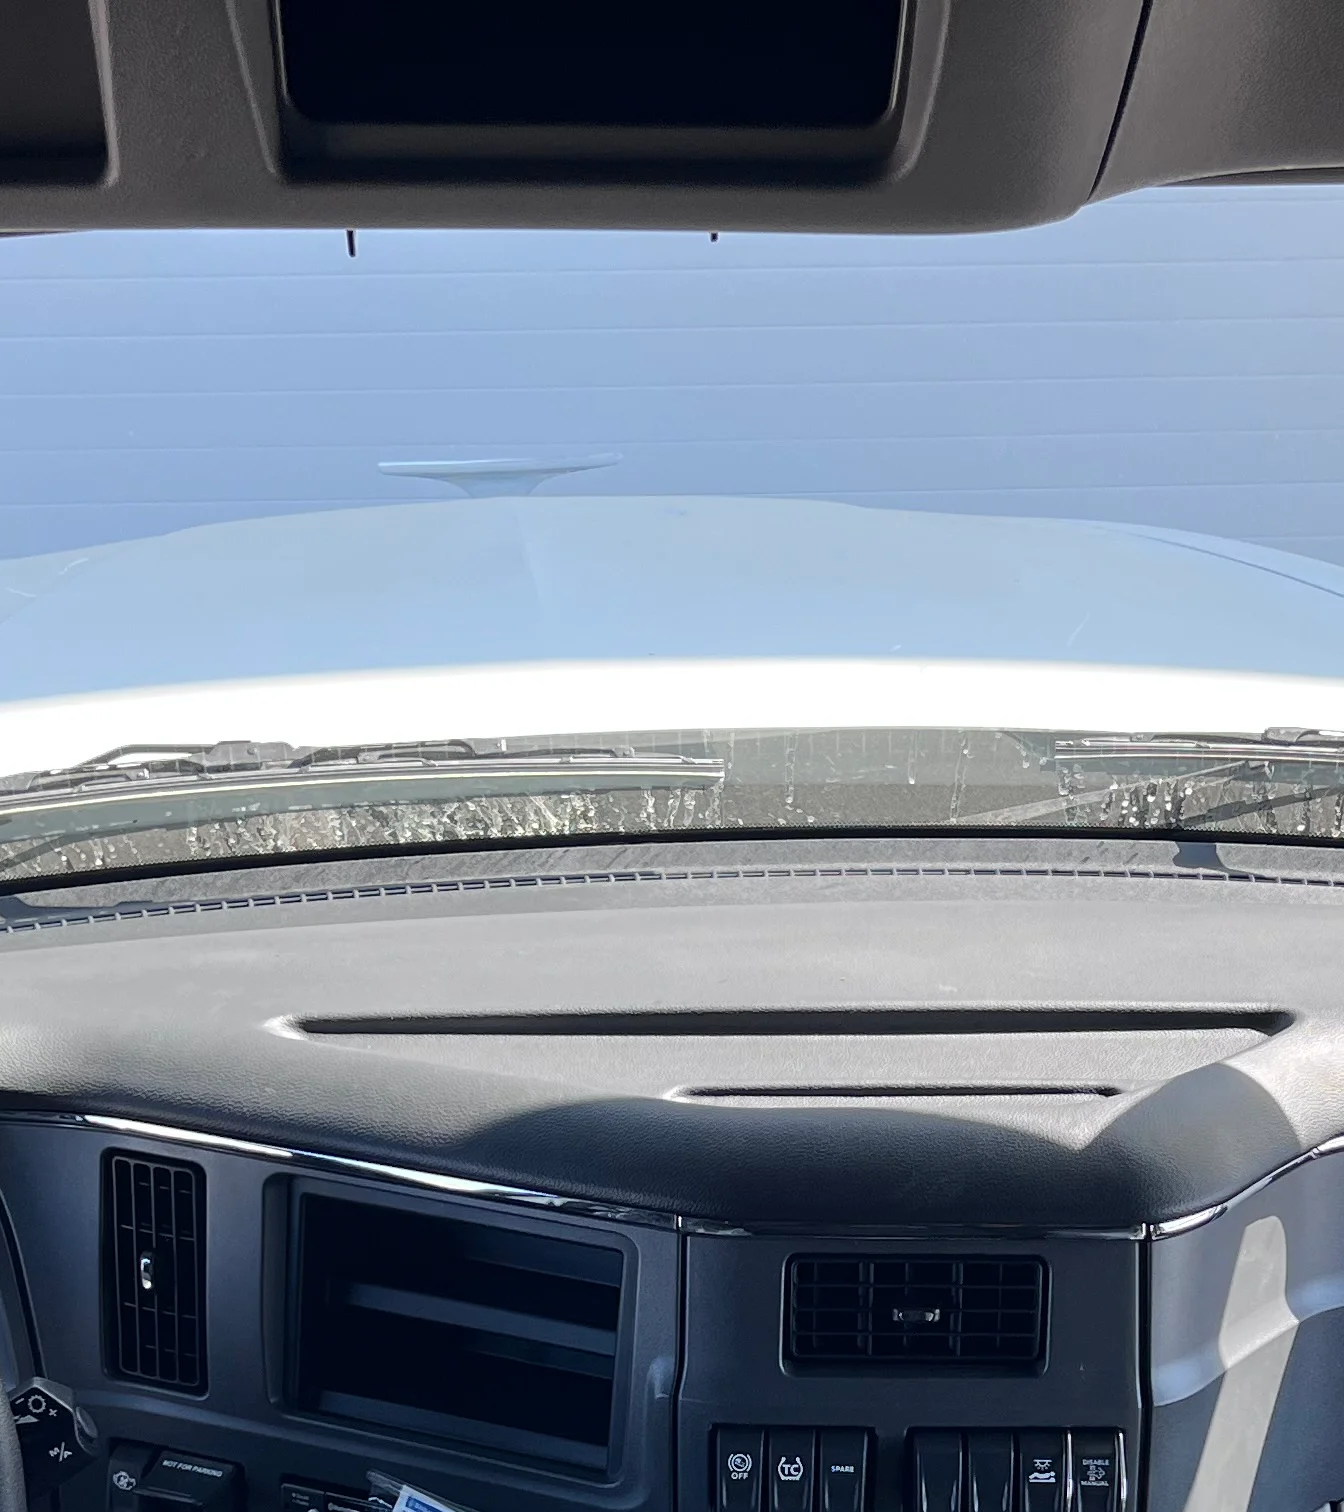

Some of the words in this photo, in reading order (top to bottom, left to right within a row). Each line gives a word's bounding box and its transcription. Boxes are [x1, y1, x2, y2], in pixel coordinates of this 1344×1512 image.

[162, 1459, 177, 1469] NOT
[177, 1462, 193, 1472] FOR
[193, 1465, 224, 1478] PARKING
[782, 1464, 799, 1475] TC
[830, 1465, 855, 1473] SPARE
[730, 1472, 749, 1480] OFF
